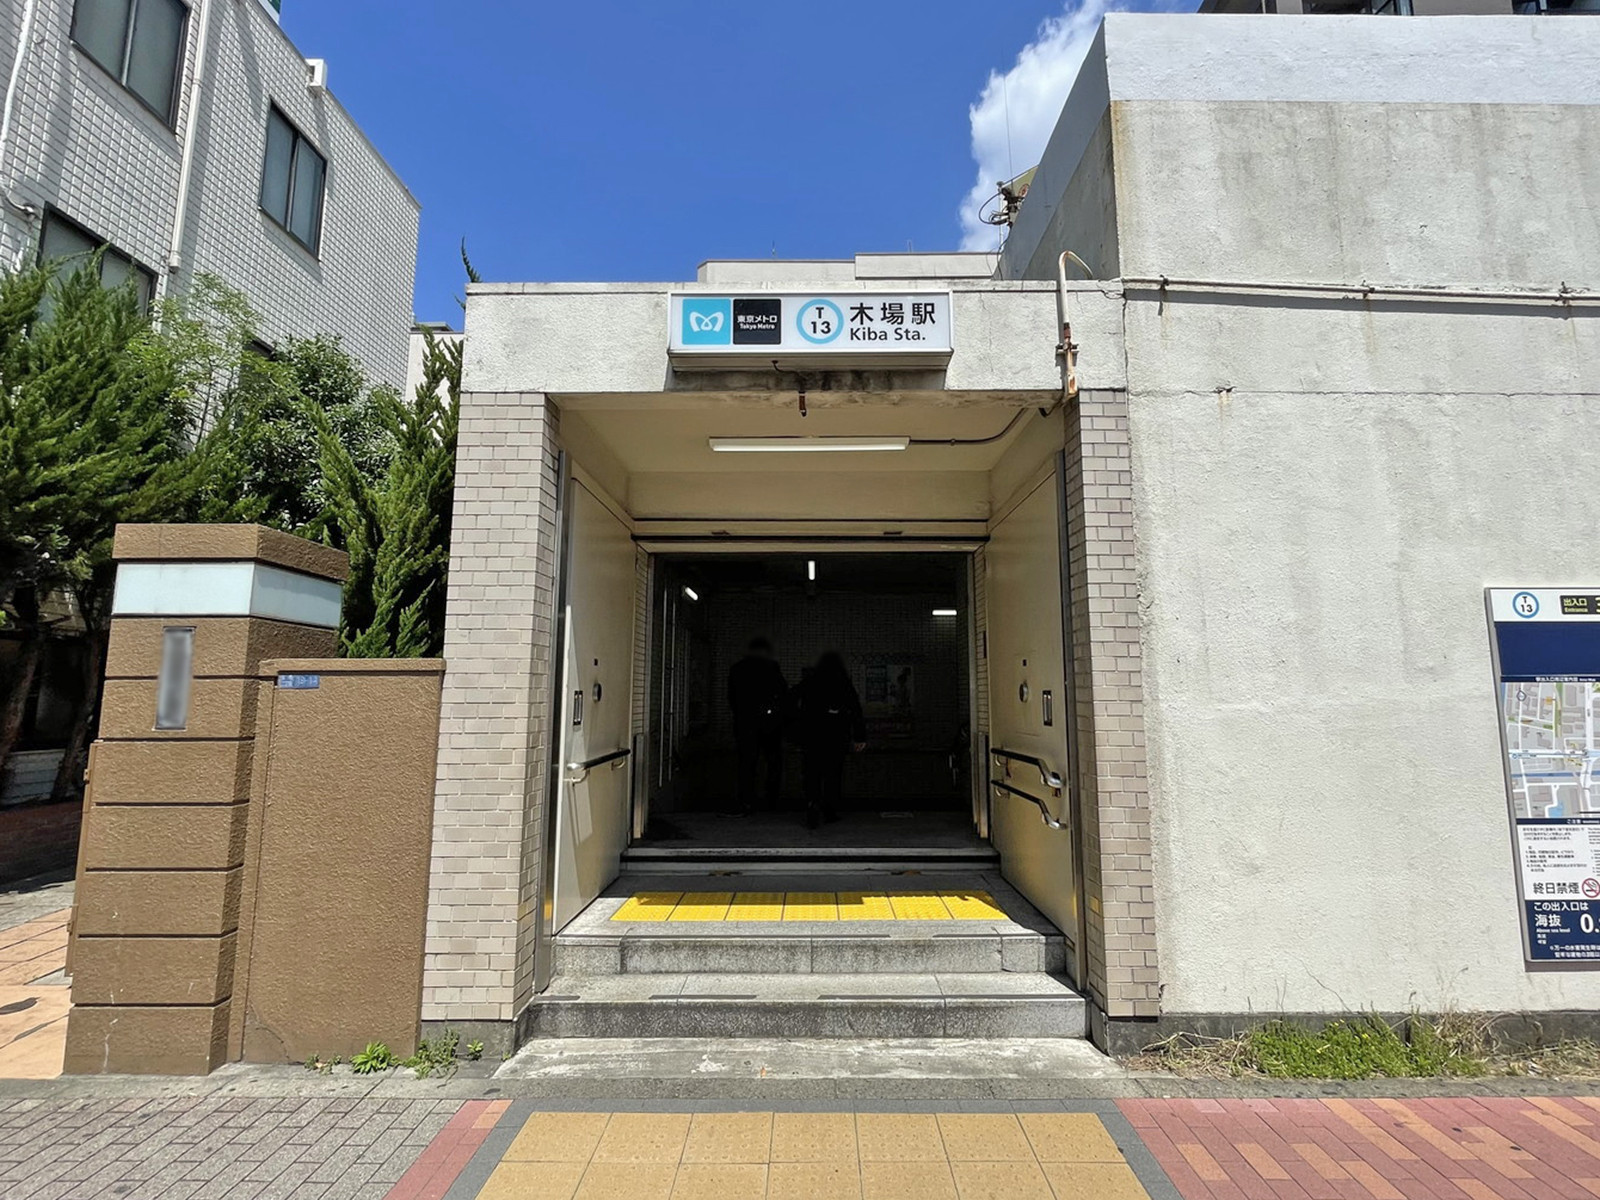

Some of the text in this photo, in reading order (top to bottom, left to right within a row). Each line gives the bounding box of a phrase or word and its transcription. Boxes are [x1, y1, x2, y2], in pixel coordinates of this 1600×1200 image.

[737, 315, 777, 323] 東京メトロ
[815, 306, 825, 319] T
[849, 302, 936, 325] 木場駅
[810, 320, 832, 335] 13
[849, 327, 926, 341] Kiba Sta.
[1520, 604, 1533, 612] 13
[1563, 598, 1587, 606] 出入口
[1533, 882, 1580, 895] 終日禁煙
[1534, 902, 1589, 911] この出入口は
[1534, 913, 1600, 934] 海抜 0.
